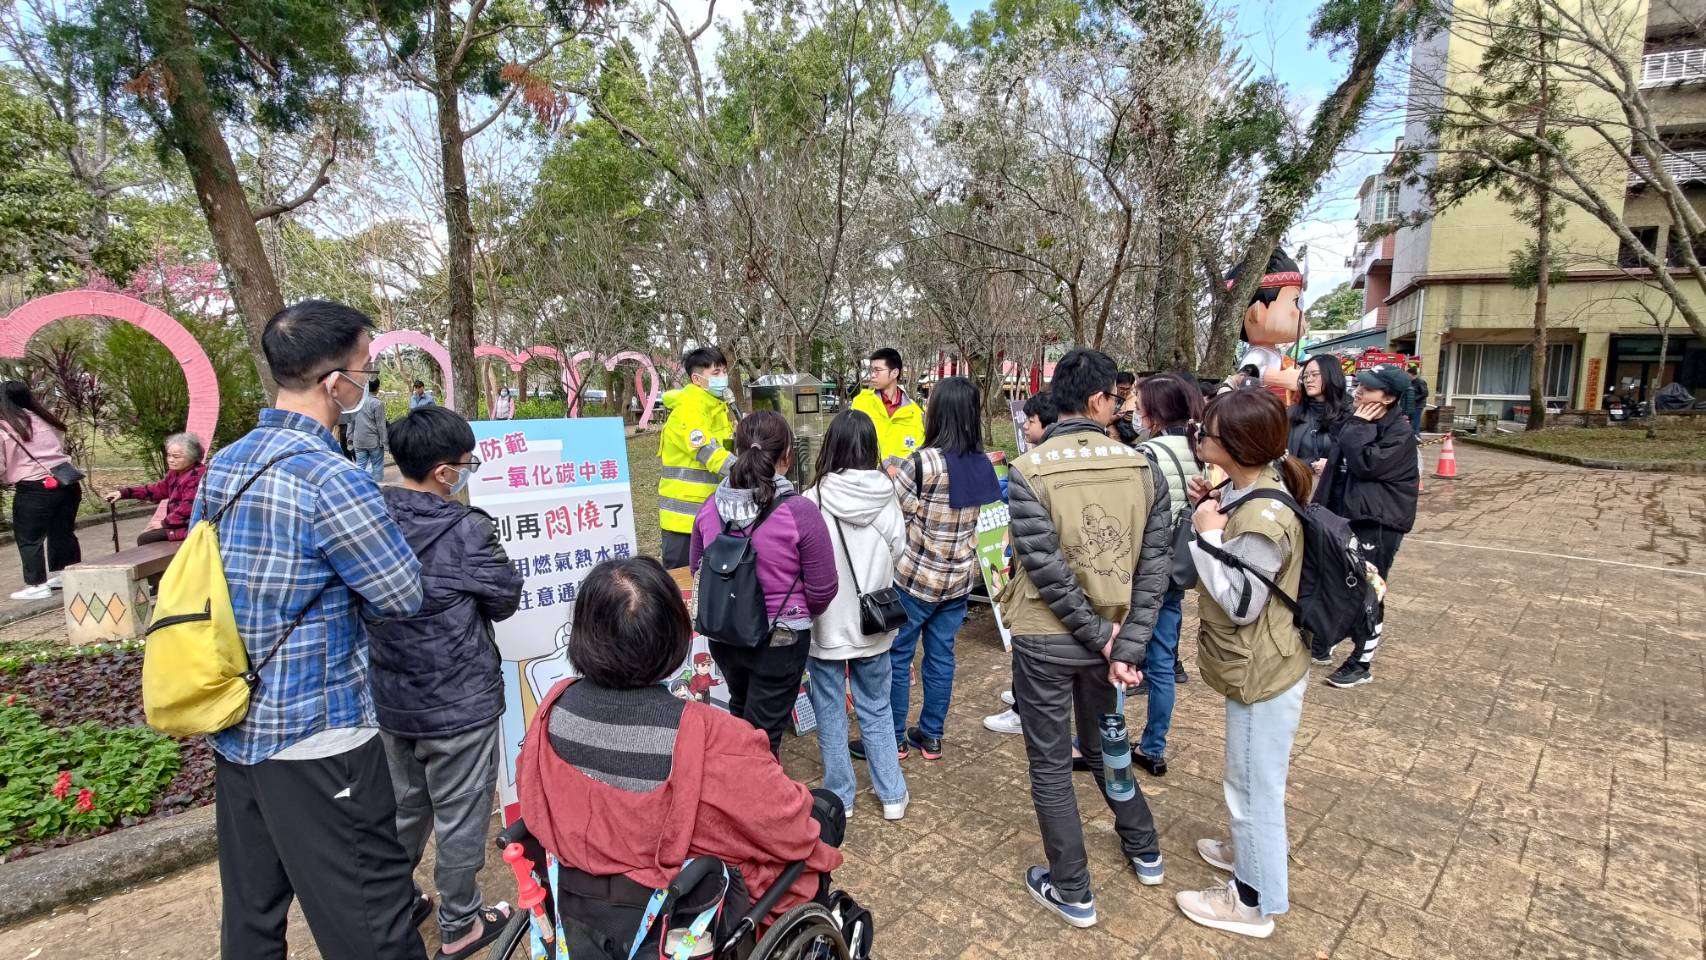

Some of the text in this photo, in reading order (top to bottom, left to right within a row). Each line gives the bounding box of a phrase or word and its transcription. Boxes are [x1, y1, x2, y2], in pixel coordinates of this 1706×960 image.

[479, 432, 528, 462] 防範
[482, 460, 618, 488] 一氧化碳中毒
[517, 580, 585, 612] 注意通
